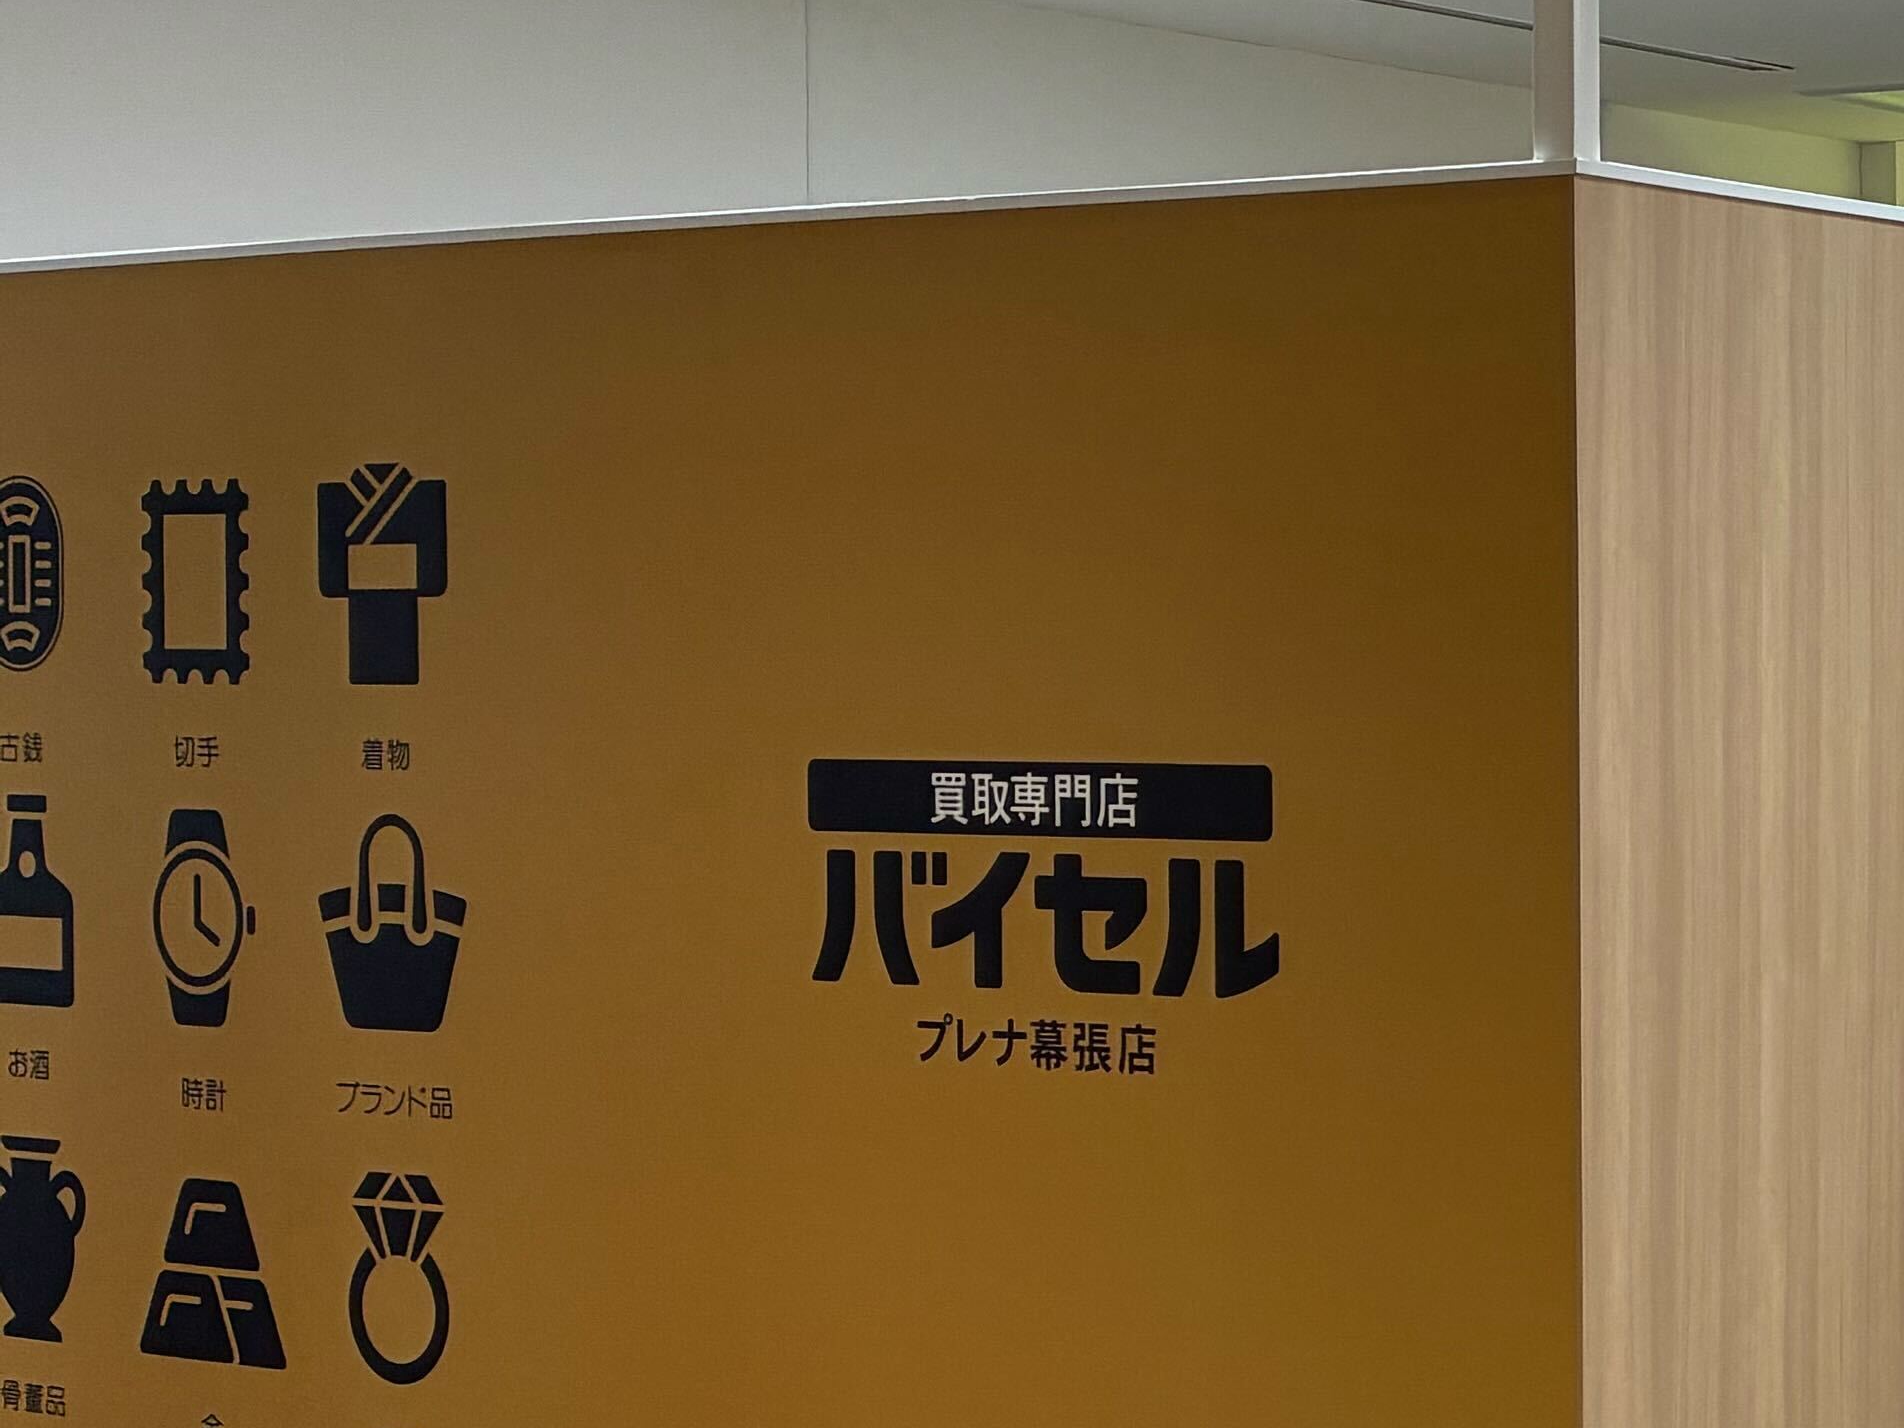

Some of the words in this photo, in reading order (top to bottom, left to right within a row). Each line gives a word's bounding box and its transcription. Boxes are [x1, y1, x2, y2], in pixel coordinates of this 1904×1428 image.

[0, 732, 43, 763] 古銭
[172, 734, 220, 768] 切手
[361, 738, 411, 772] 着物
[930, 772, 1140, 828] 買取専門店
[812, 849, 1280, 999] バイセル
[917, 1013, 1157, 1075] プレナ幕張店
[6, 1049, 51, 1082] お酒
[181, 1079, 227, 1113] 時計
[335, 1081, 454, 1121] ブランド品
[0, 1379, 66, 1417] 骨董品
